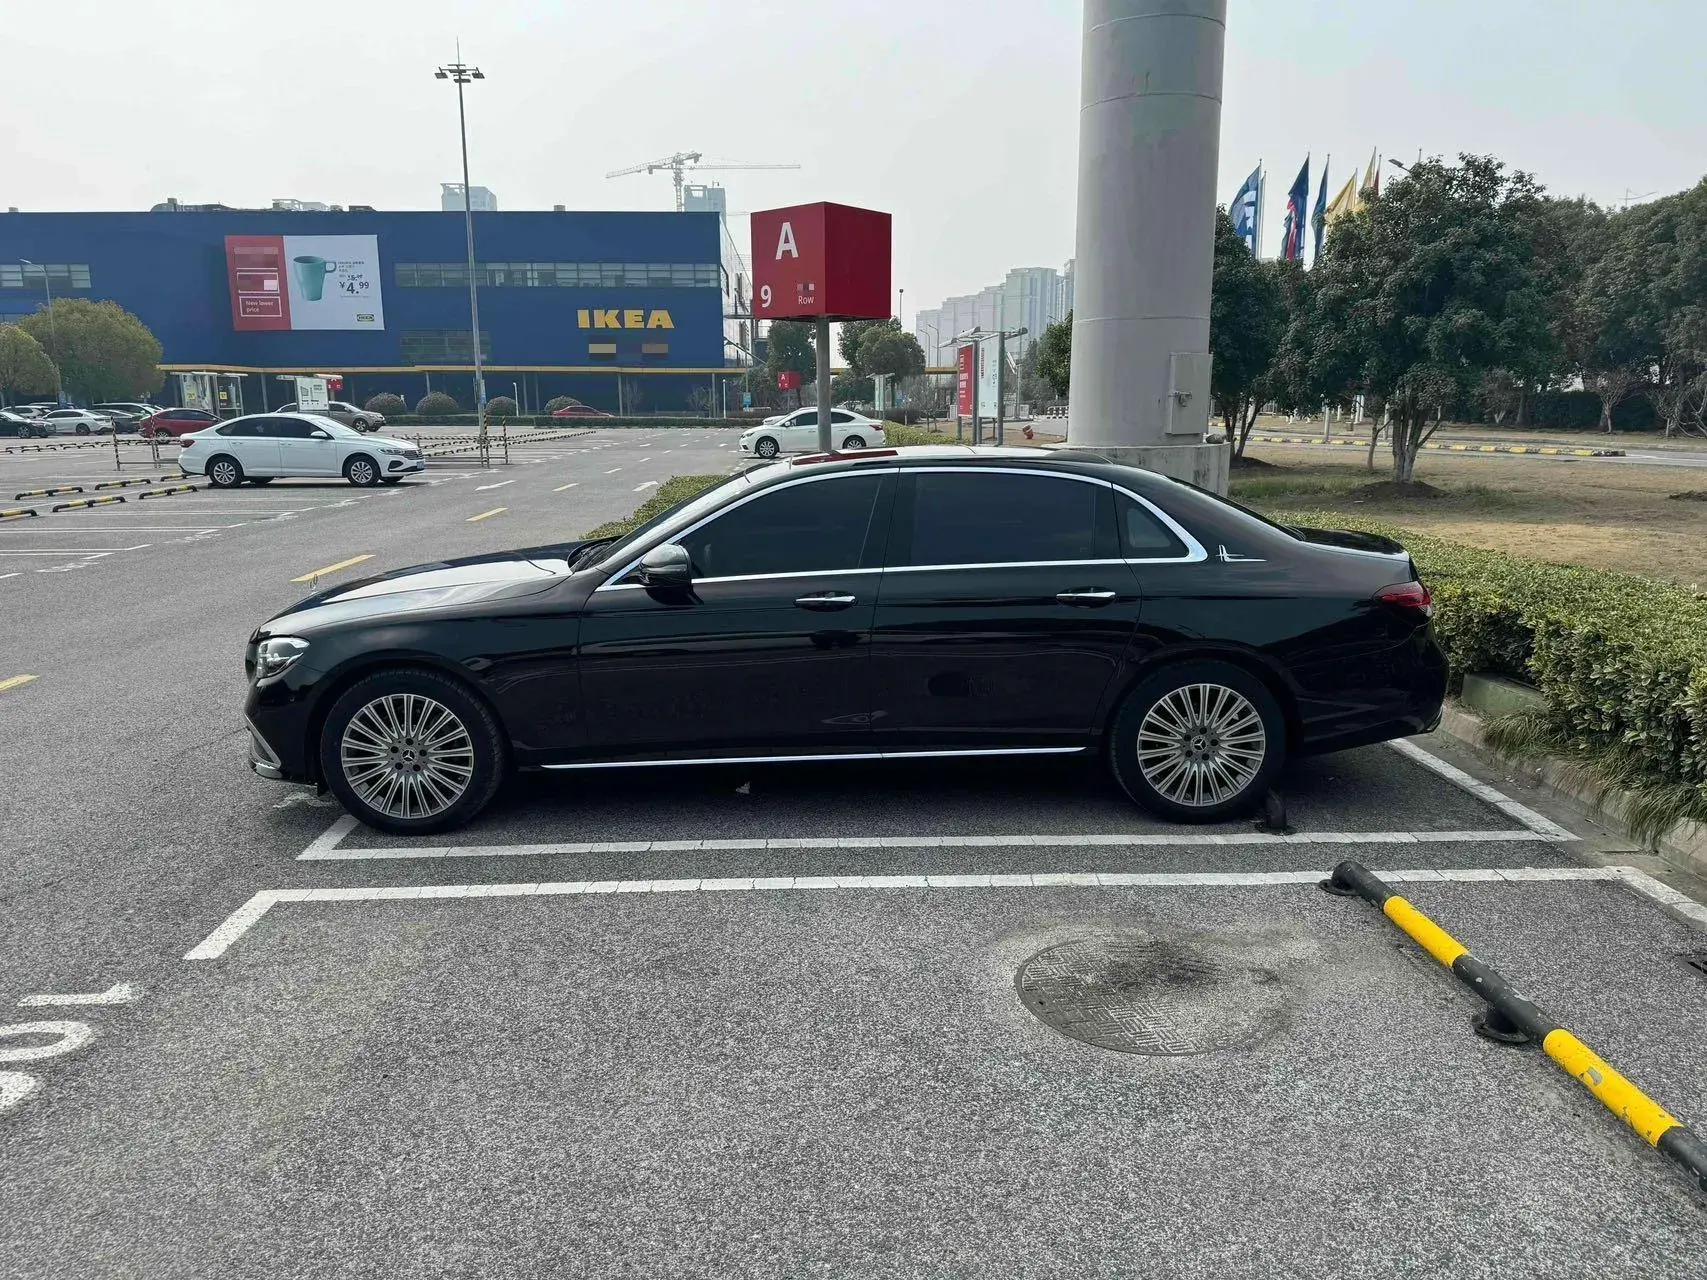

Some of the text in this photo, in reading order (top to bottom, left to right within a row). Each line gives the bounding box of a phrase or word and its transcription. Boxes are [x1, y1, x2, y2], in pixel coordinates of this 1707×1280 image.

[775, 222, 799, 260] A
[760, 284, 772, 308] 9
[798, 295, 815, 305] Row
[577, 309, 675, 329] IKEA
